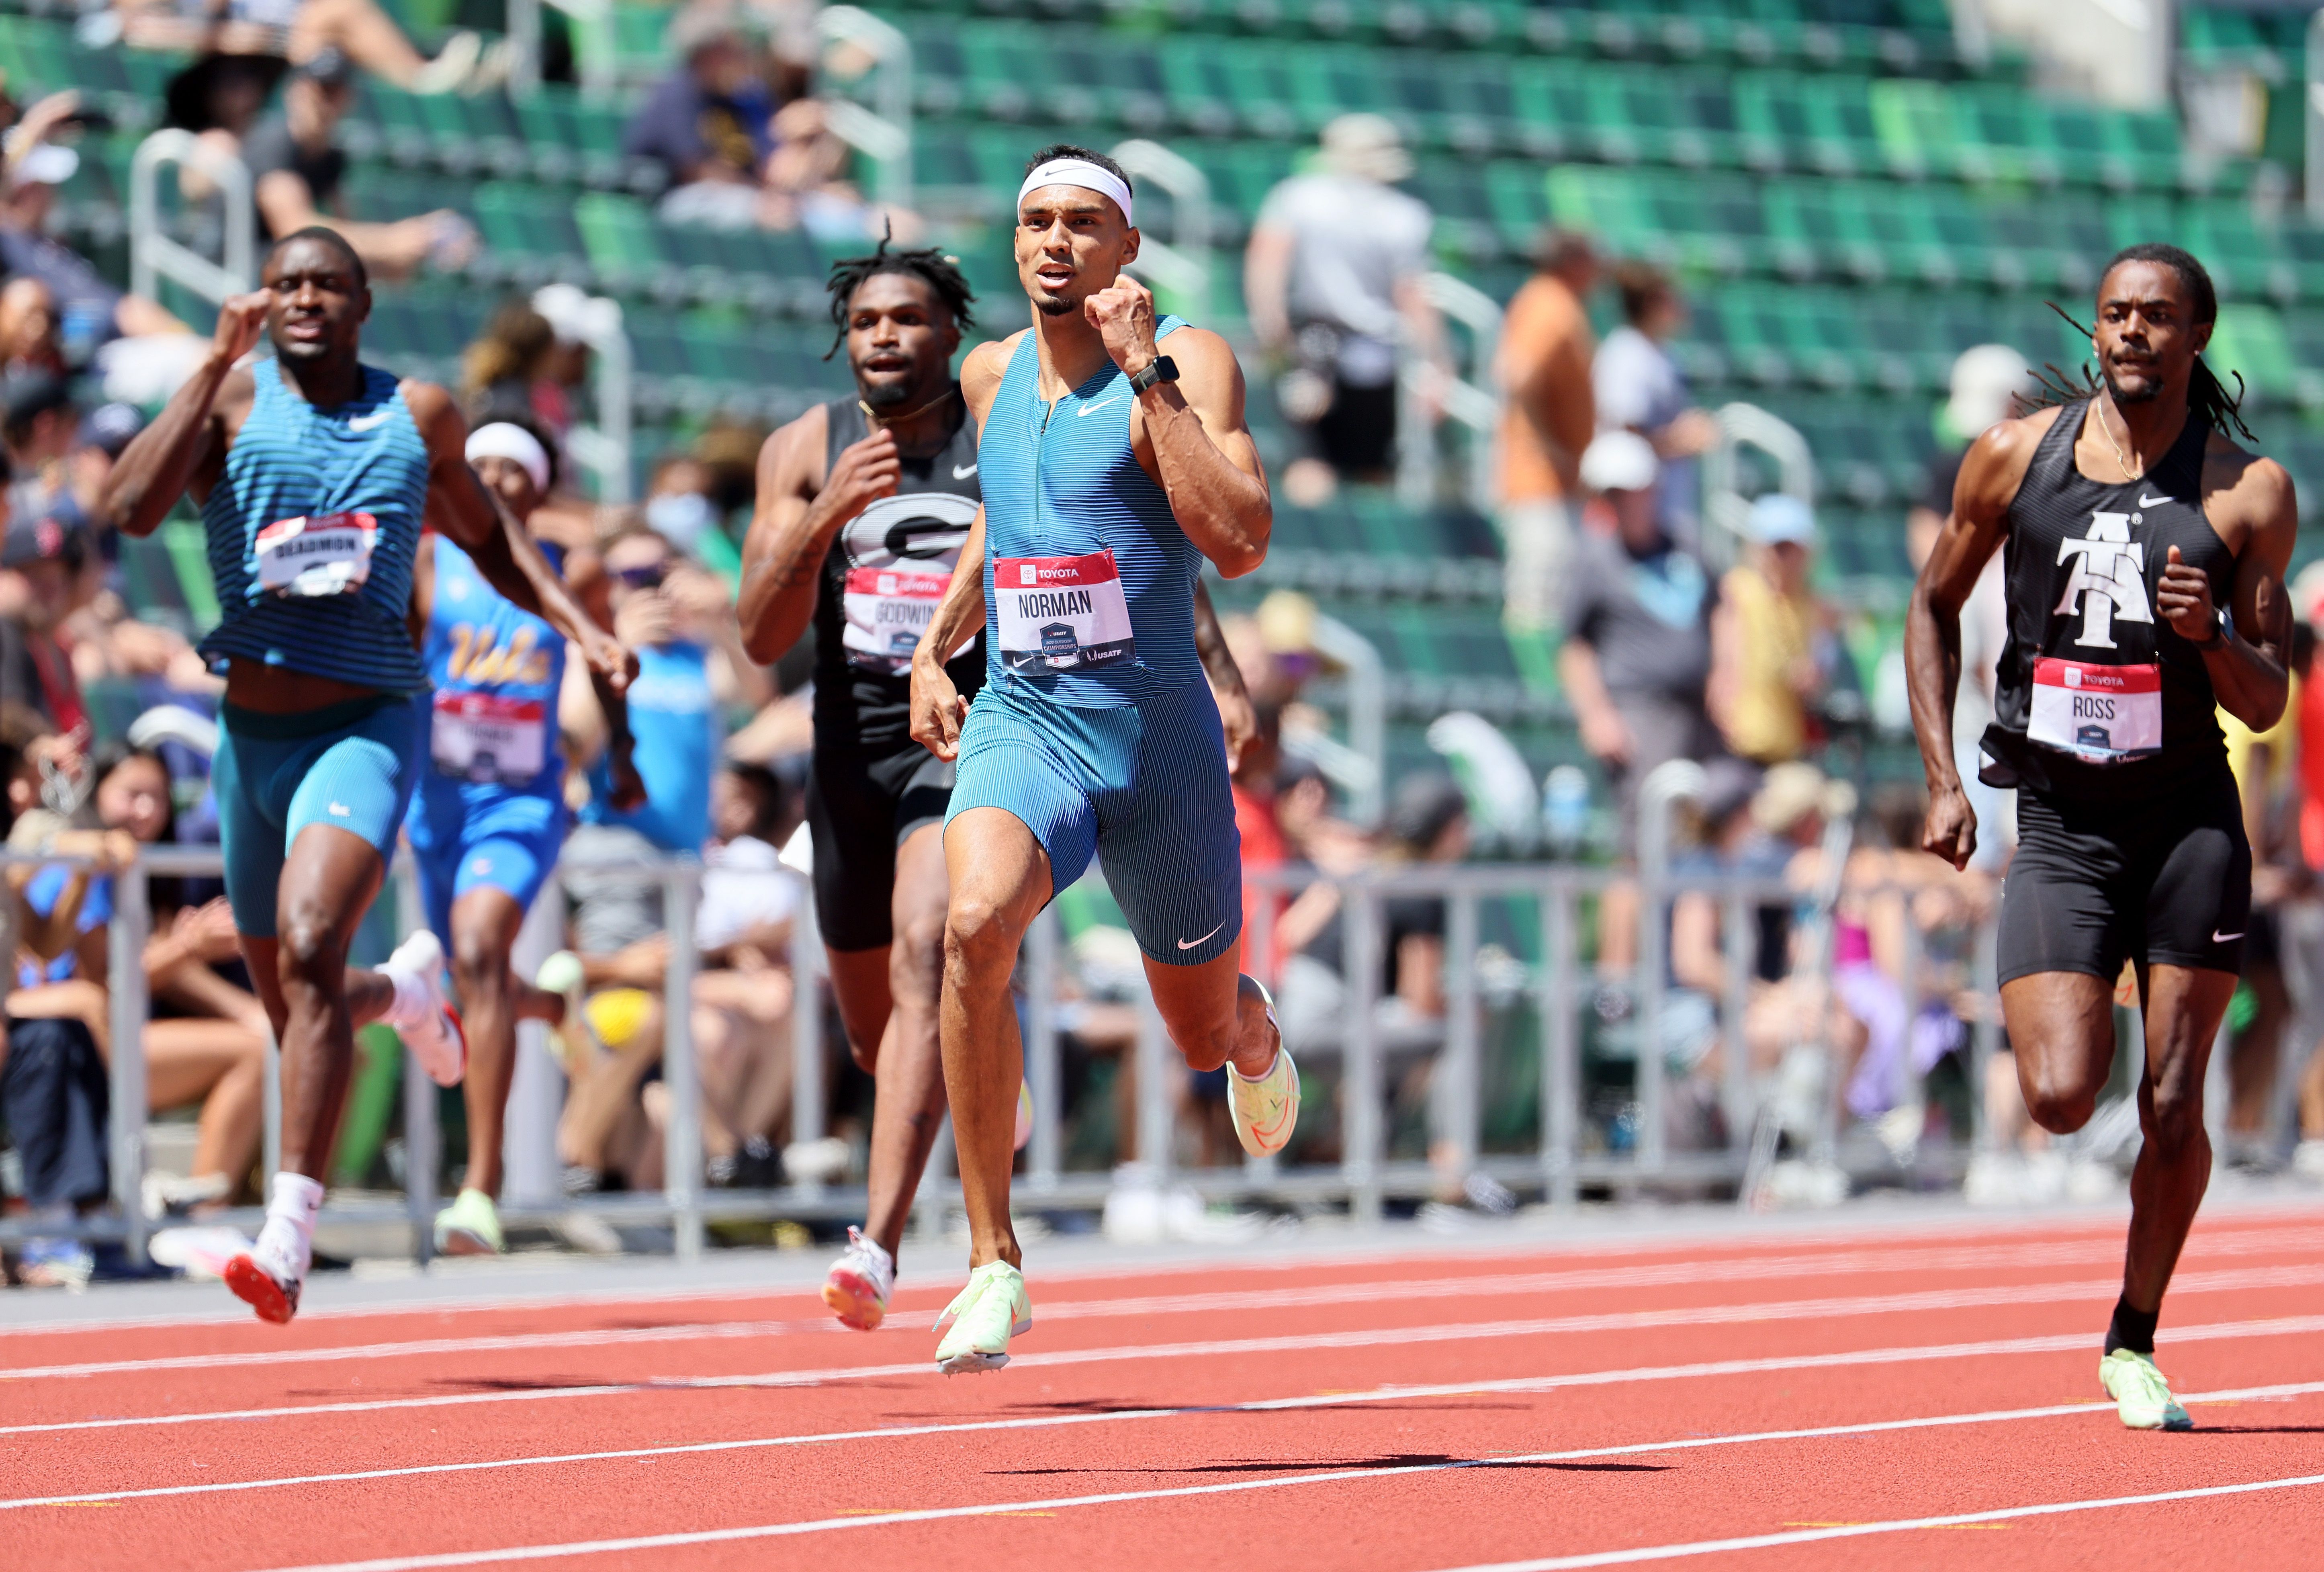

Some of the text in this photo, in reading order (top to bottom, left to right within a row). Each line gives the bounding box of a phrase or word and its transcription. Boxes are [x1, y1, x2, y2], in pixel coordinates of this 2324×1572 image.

[1039, 569, 1079, 579] TOYOTA
[1018, 590, 1092, 618] NORMAN
[1097, 649, 1121, 659] USATF
[2083, 674, 2124, 687] TOYOTA
[2074, 696, 2115, 720] ROSS
